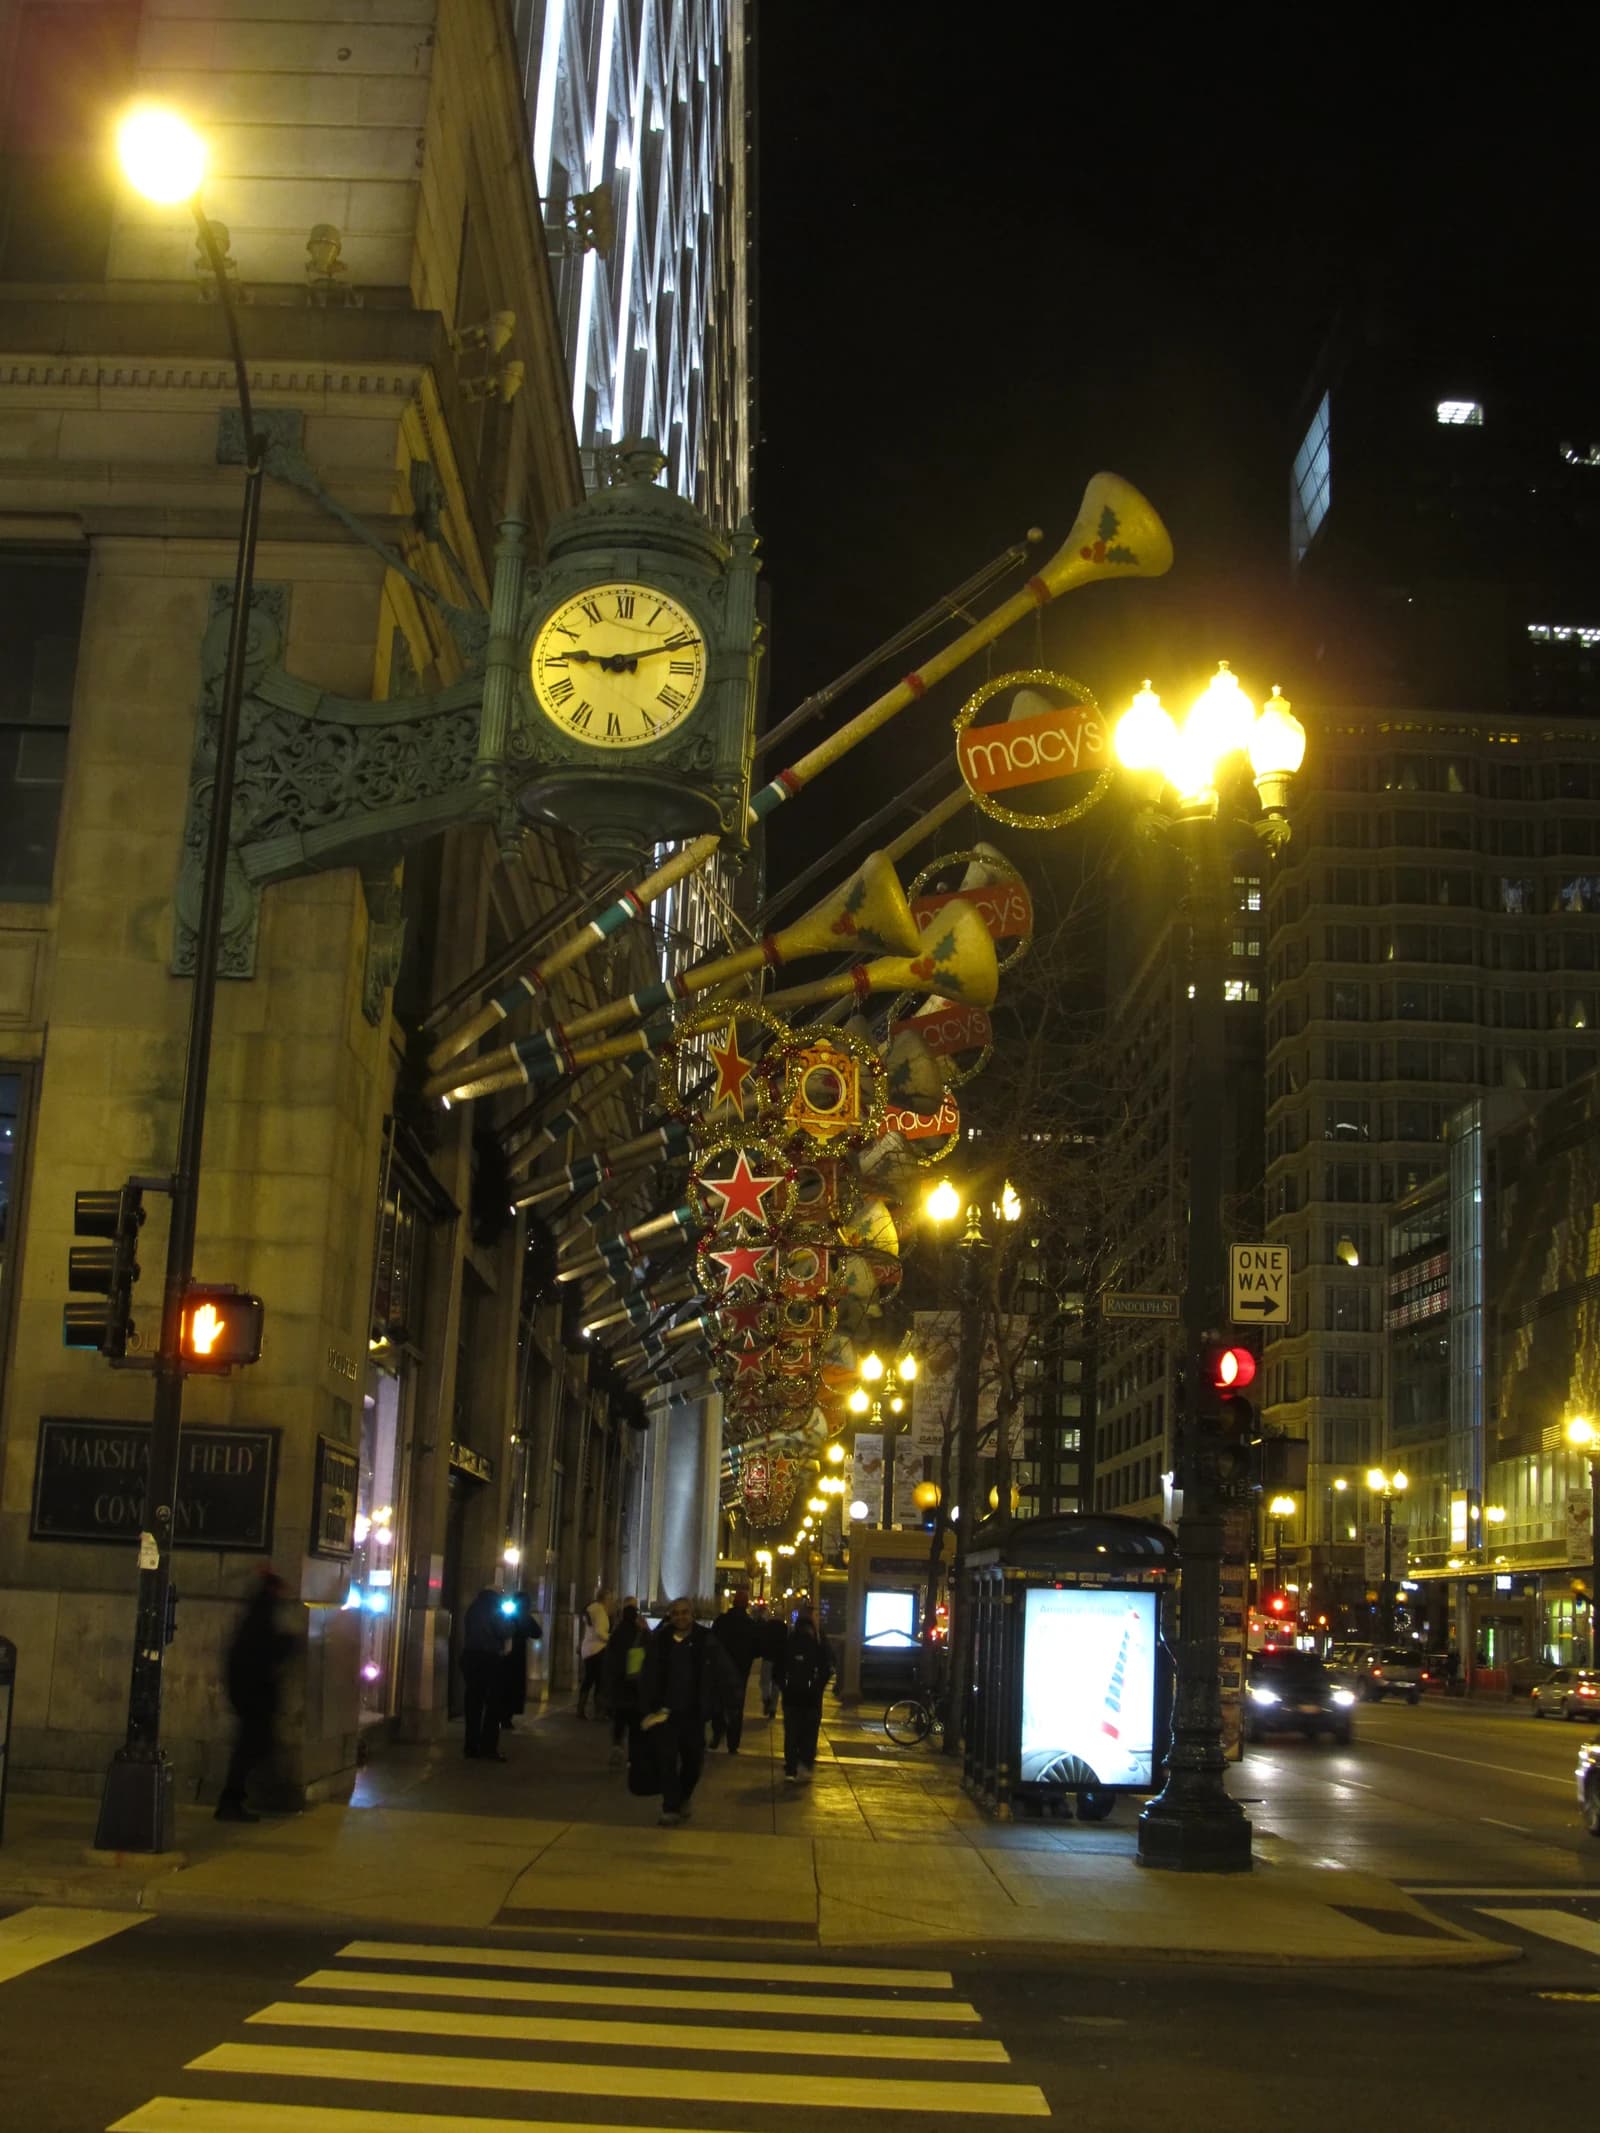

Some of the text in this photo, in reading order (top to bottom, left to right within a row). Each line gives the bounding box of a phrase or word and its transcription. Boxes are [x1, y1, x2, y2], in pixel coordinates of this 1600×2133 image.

[582, 600, 603, 627] XI
[616, 595, 635, 619] XII
[646, 607, 662, 627] I
[556, 627, 580, 643] X
[670, 661, 694, 676] III
[548, 678, 575, 706] VIII
[656, 684, 686, 712] IIII
[571, 701, 594, 729] VII
[607, 712, 621, 737] VI
[641, 709, 656, 731] V
[967, 711, 1104, 780] macy's
[1239, 1251, 1283, 1270] ONE
[1238, 1272, 1283, 1292] WAY
[1107, 1298, 1160, 1313] RANDOLPH
[58, 1437, 254, 1474] MARSHA FIELD
[94, 1495, 210, 1529] COMNY
